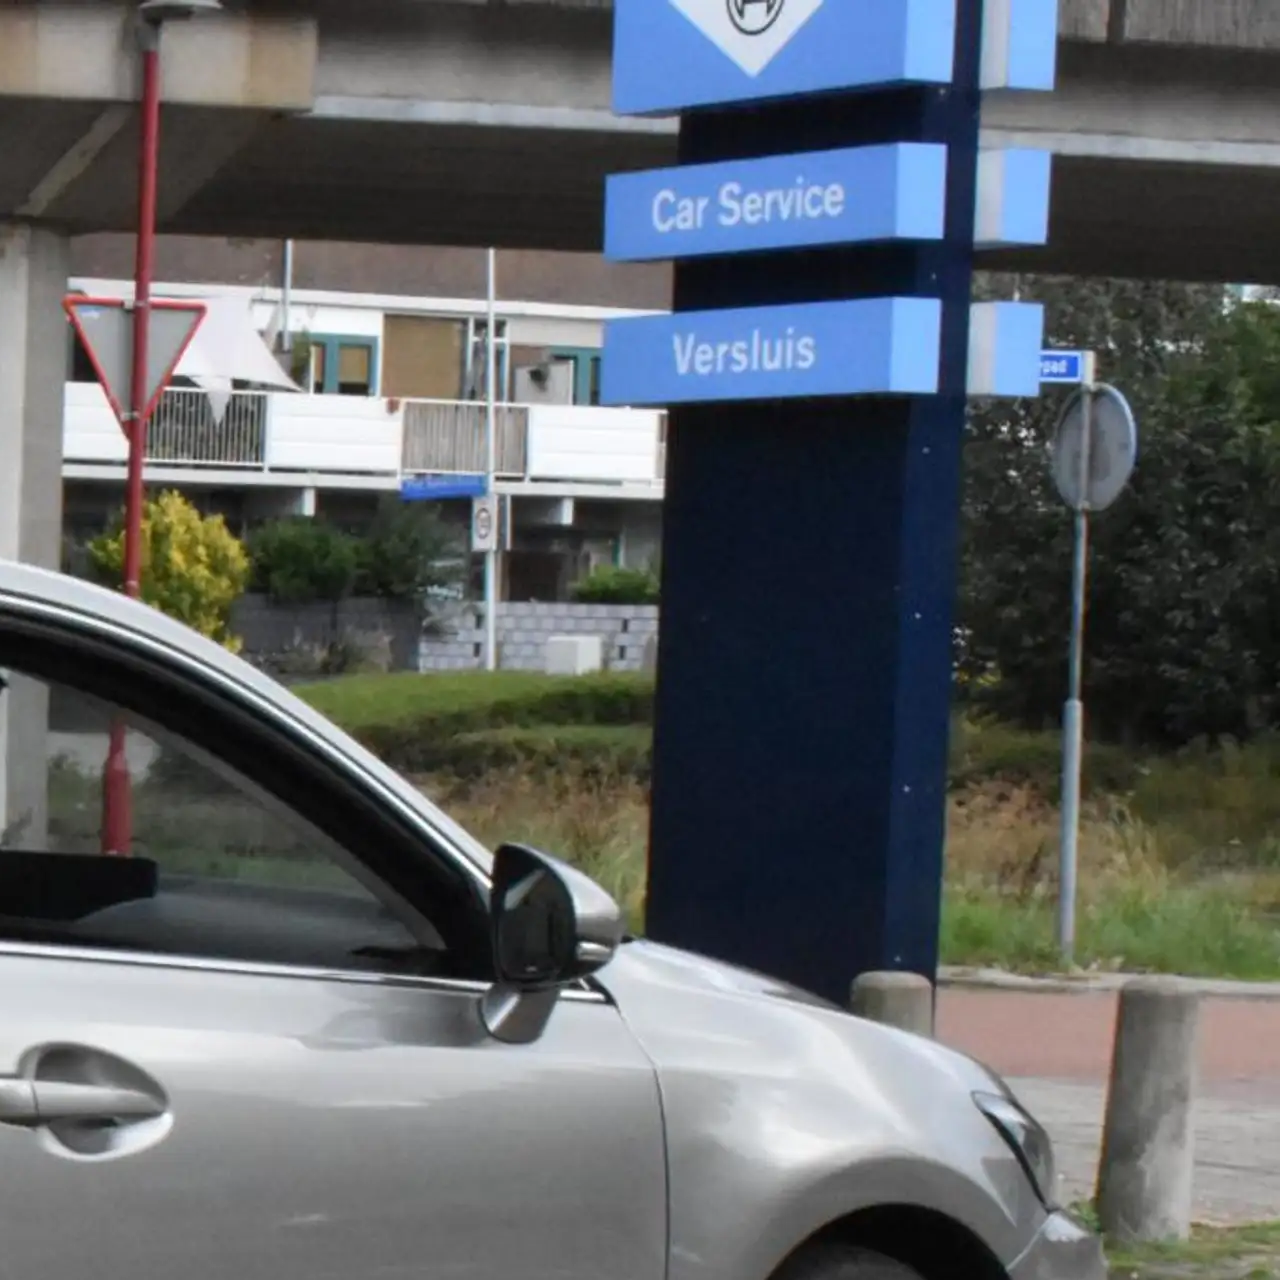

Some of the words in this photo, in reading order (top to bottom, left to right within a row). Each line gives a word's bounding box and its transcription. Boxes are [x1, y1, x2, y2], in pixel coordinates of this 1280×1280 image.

[652, 188, 709, 233] Car
[717, 175, 845, 227] Service
[672, 326, 817, 376] Versluis
